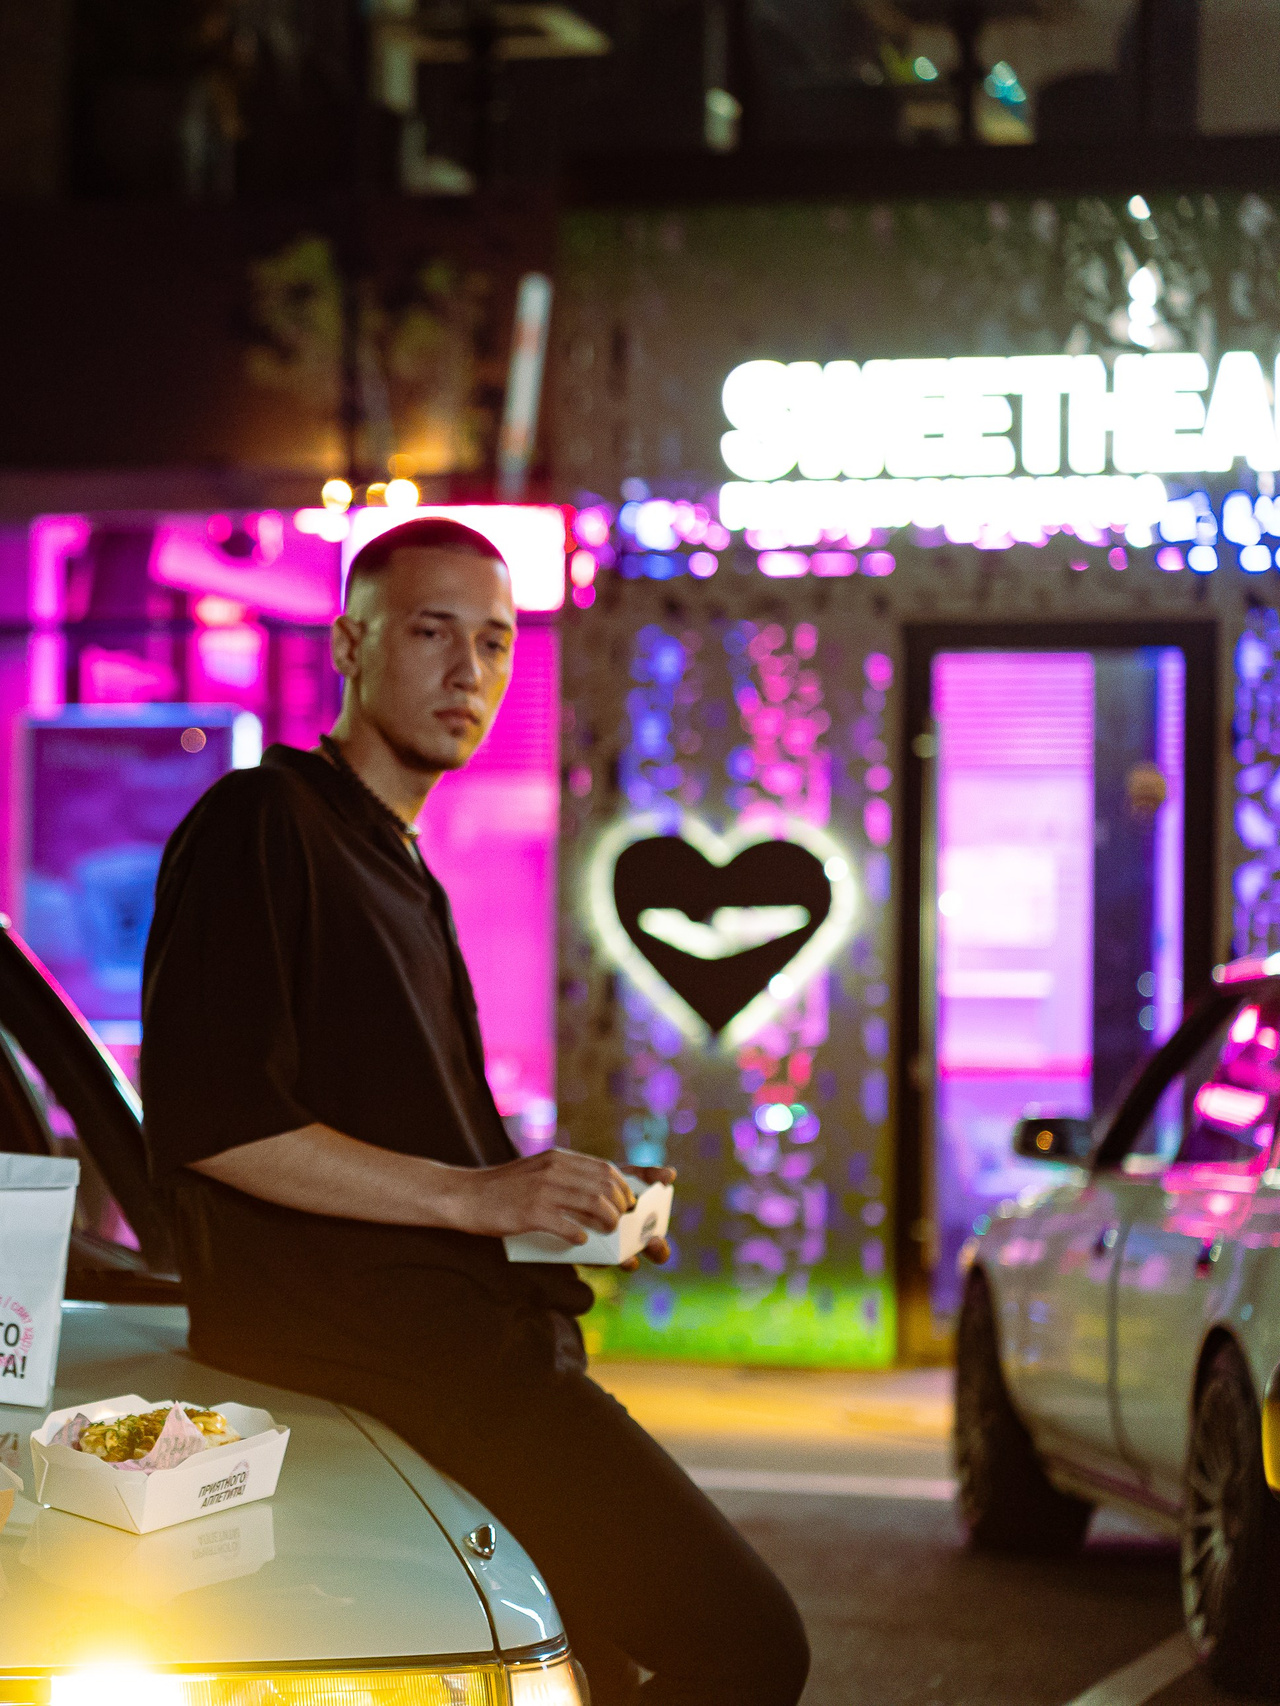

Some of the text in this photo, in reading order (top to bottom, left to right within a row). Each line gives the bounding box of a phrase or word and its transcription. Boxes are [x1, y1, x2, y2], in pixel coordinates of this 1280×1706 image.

[721, 351, 1280, 480] SWEETHEA
[198, 1471, 247, 1498] ПРИЯТНОГО
[200, 1484, 246, 1509] АППЕТИТА!
